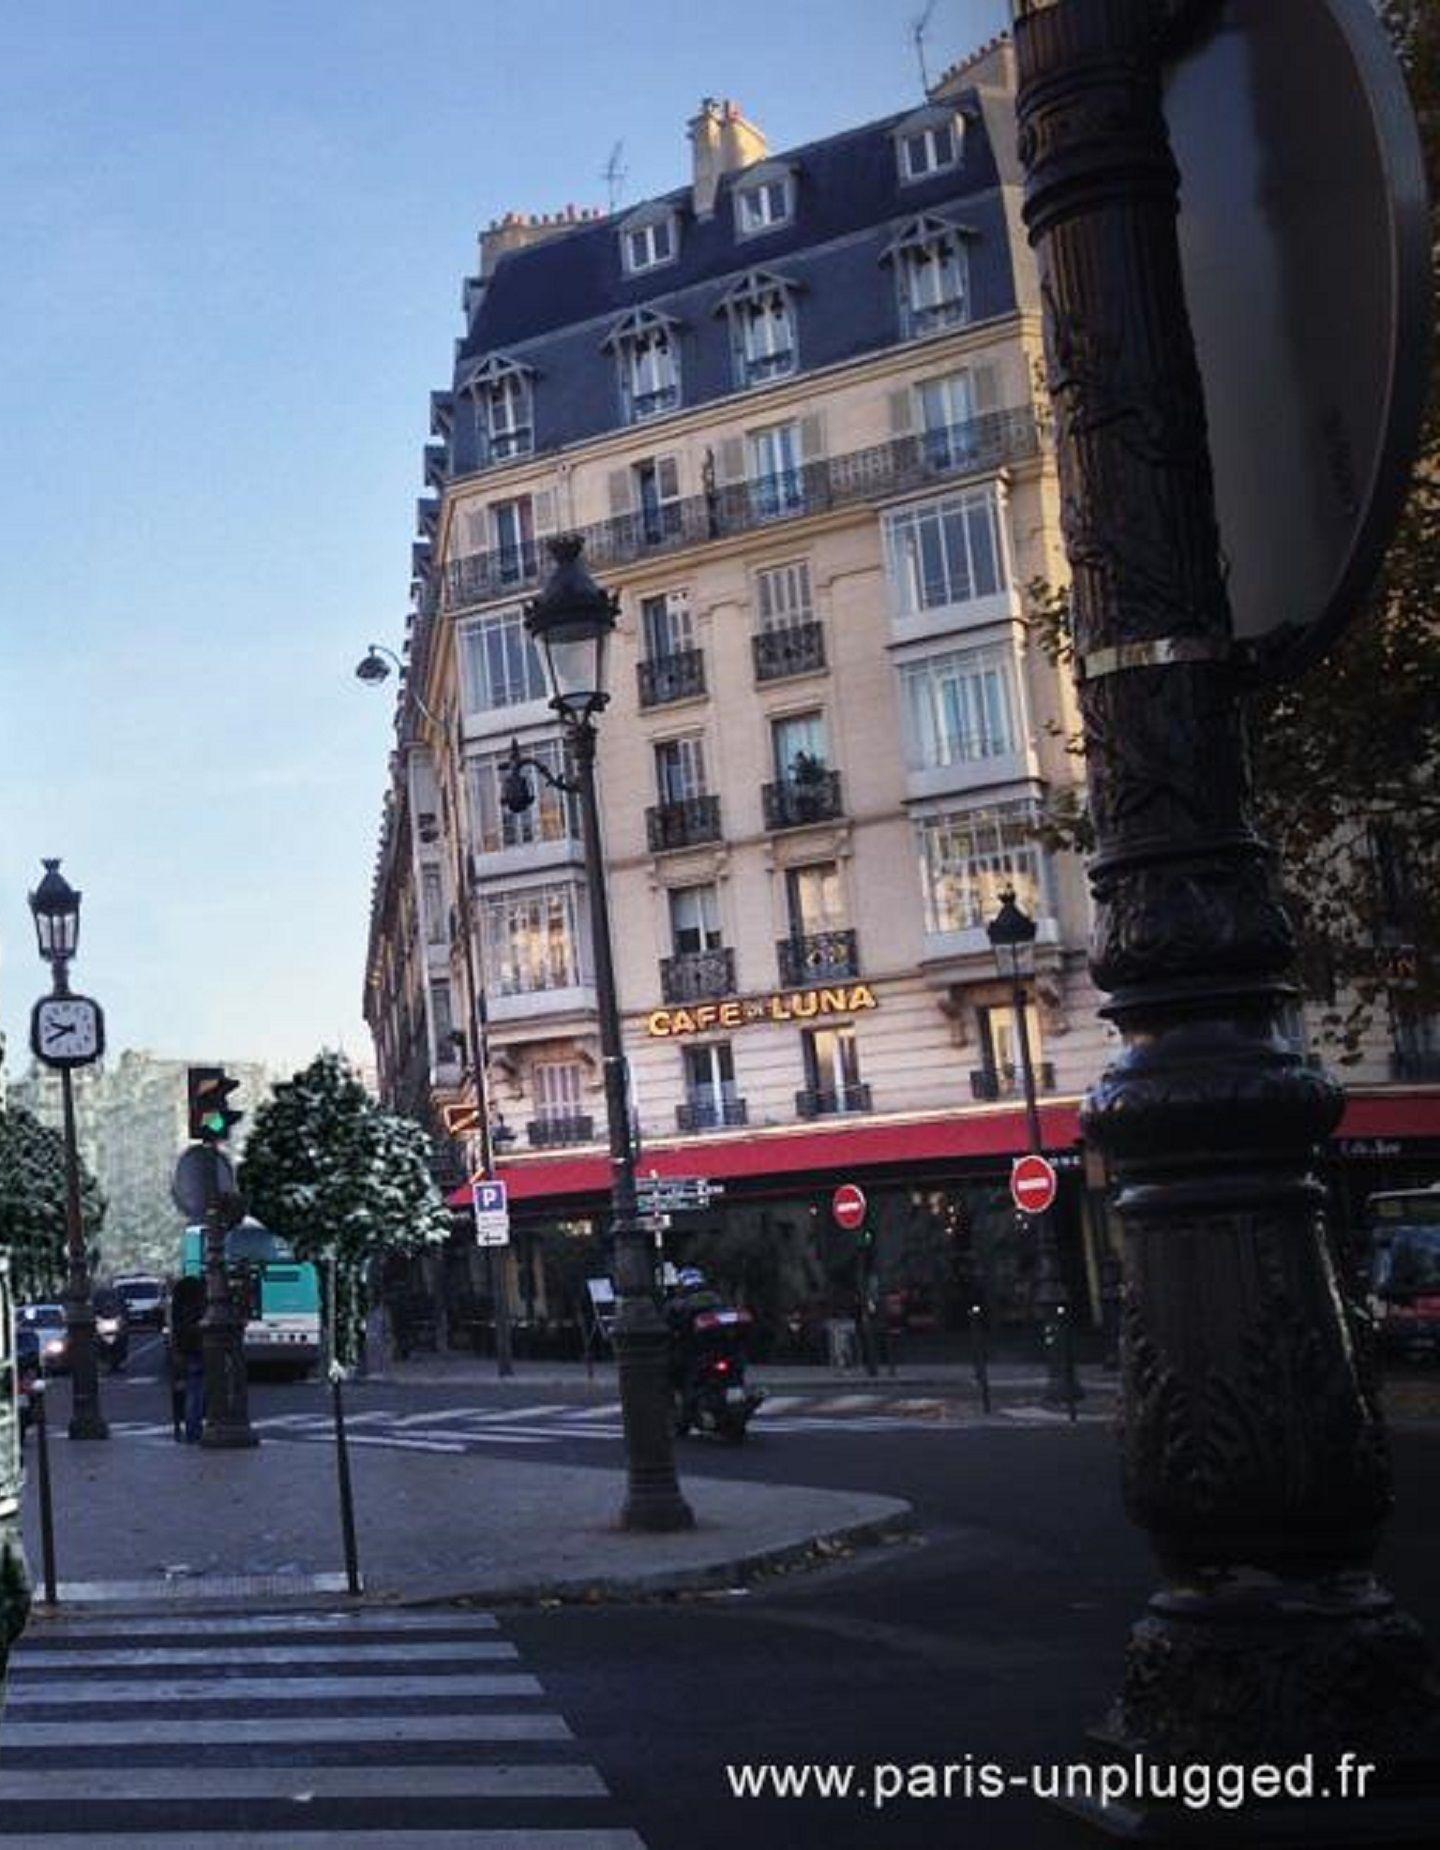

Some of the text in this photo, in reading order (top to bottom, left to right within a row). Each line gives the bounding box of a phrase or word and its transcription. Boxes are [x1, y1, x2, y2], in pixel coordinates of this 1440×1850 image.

[648, 985, 877, 1036] CAFE LUNA
[483, 1188, 497, 1207] P
